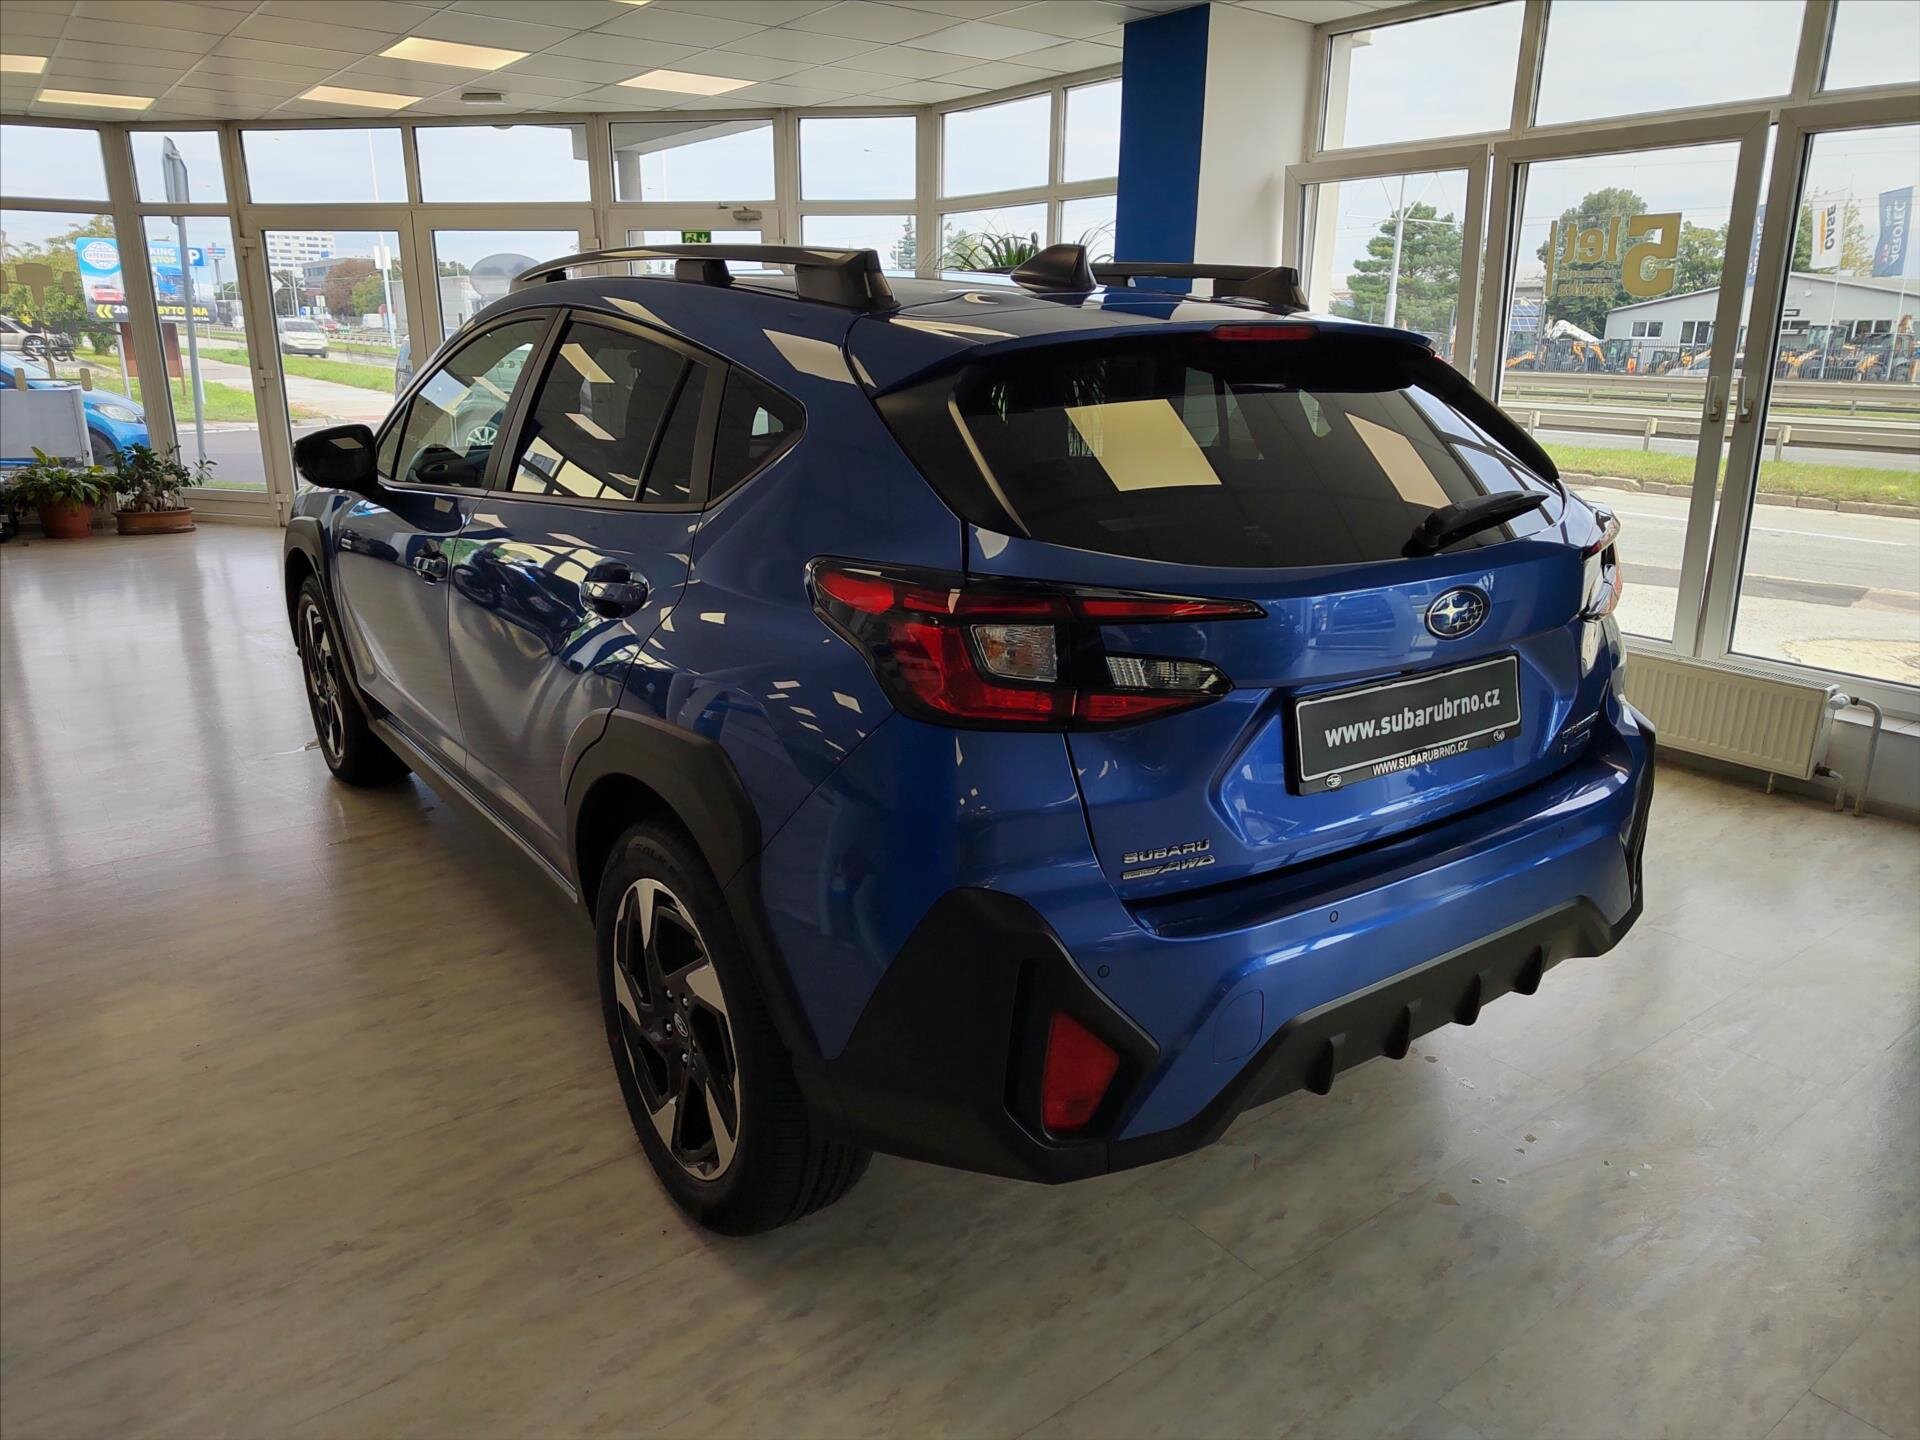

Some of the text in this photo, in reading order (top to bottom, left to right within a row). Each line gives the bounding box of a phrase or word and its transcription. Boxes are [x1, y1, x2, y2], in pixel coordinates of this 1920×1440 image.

[149, 248, 176, 257] KING
[188, 249, 200, 265] P
[157, 305, 208, 316] BYTONA
[1325, 688, 1500, 748] www.subarubrno.cz
[1372, 740, 1469, 776] WWW.SUBARUBRNO.CZ
[1123, 840, 1209, 864] SUBARU
[1160, 855, 1216, 873] AWD
